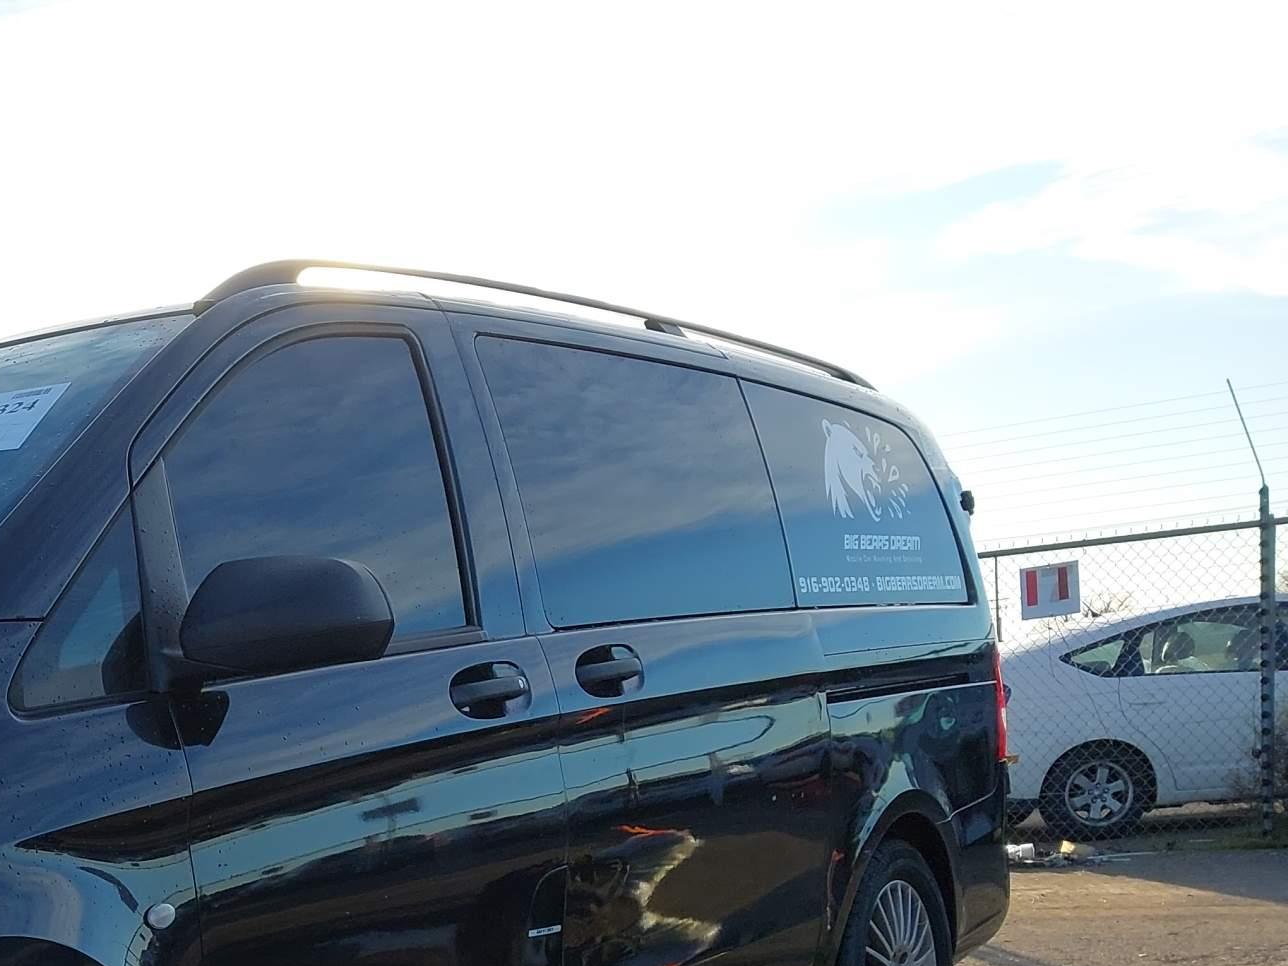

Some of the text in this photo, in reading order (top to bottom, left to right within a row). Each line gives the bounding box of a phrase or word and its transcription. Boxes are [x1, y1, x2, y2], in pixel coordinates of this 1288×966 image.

[843, 534, 921, 551] BIG BEARS DREAM
[799, 576, 871, 593] 916-902-0348
